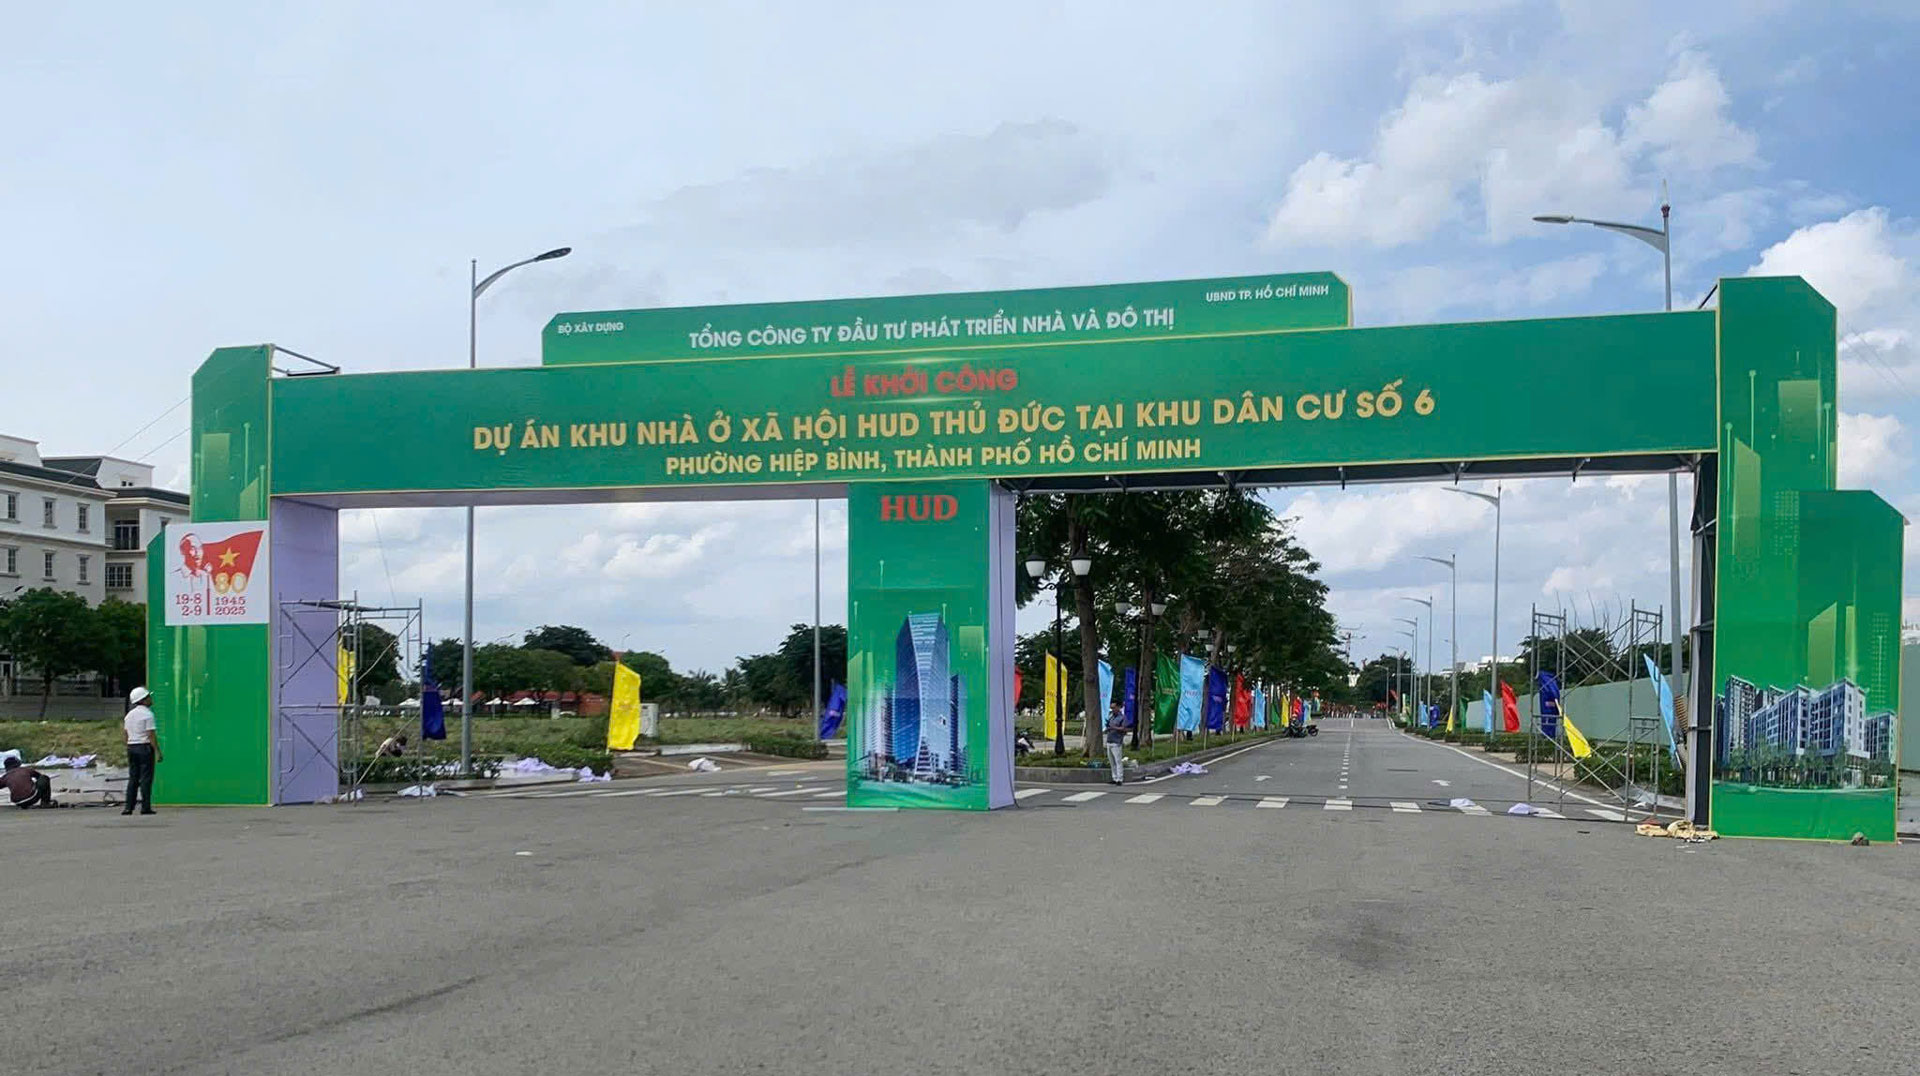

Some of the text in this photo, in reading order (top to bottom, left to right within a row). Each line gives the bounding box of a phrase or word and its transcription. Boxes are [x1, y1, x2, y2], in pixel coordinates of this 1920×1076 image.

[1205, 290, 1236, 303] UBND
[1239, 289, 1253, 301] TP.
[1275, 284, 1297, 298] CHÍ
[1299, 285, 1329, 297] MINH
[557, 321, 625, 336] BỘ XÂY DỰNG
[689, 306, 1174, 349] TỔNG CÔNG TY ĐẦU TƯ PHÁT TRIỂN NHÀ VÀ ĐÔ THỊ
[831, 363, 1019, 397] LỄ KHỞI CÔNG
[473, 379, 1435, 456] DỰ ÁN KHU NHÀ Ở XÃ HỘI HUD THỦ ĐỨC TẠI KHU DÂN CƯ SỐ 6
[666, 434, 1201, 477] PHƯỜNG HIỆP BÌNH, THÀNH PHỐ HỒ CHÍ MINH
[880, 494, 958, 521] HUD
[214, 571, 247, 594] 80
[215, 595, 246, 606] 1945
[215, 606, 246, 616] 2025
